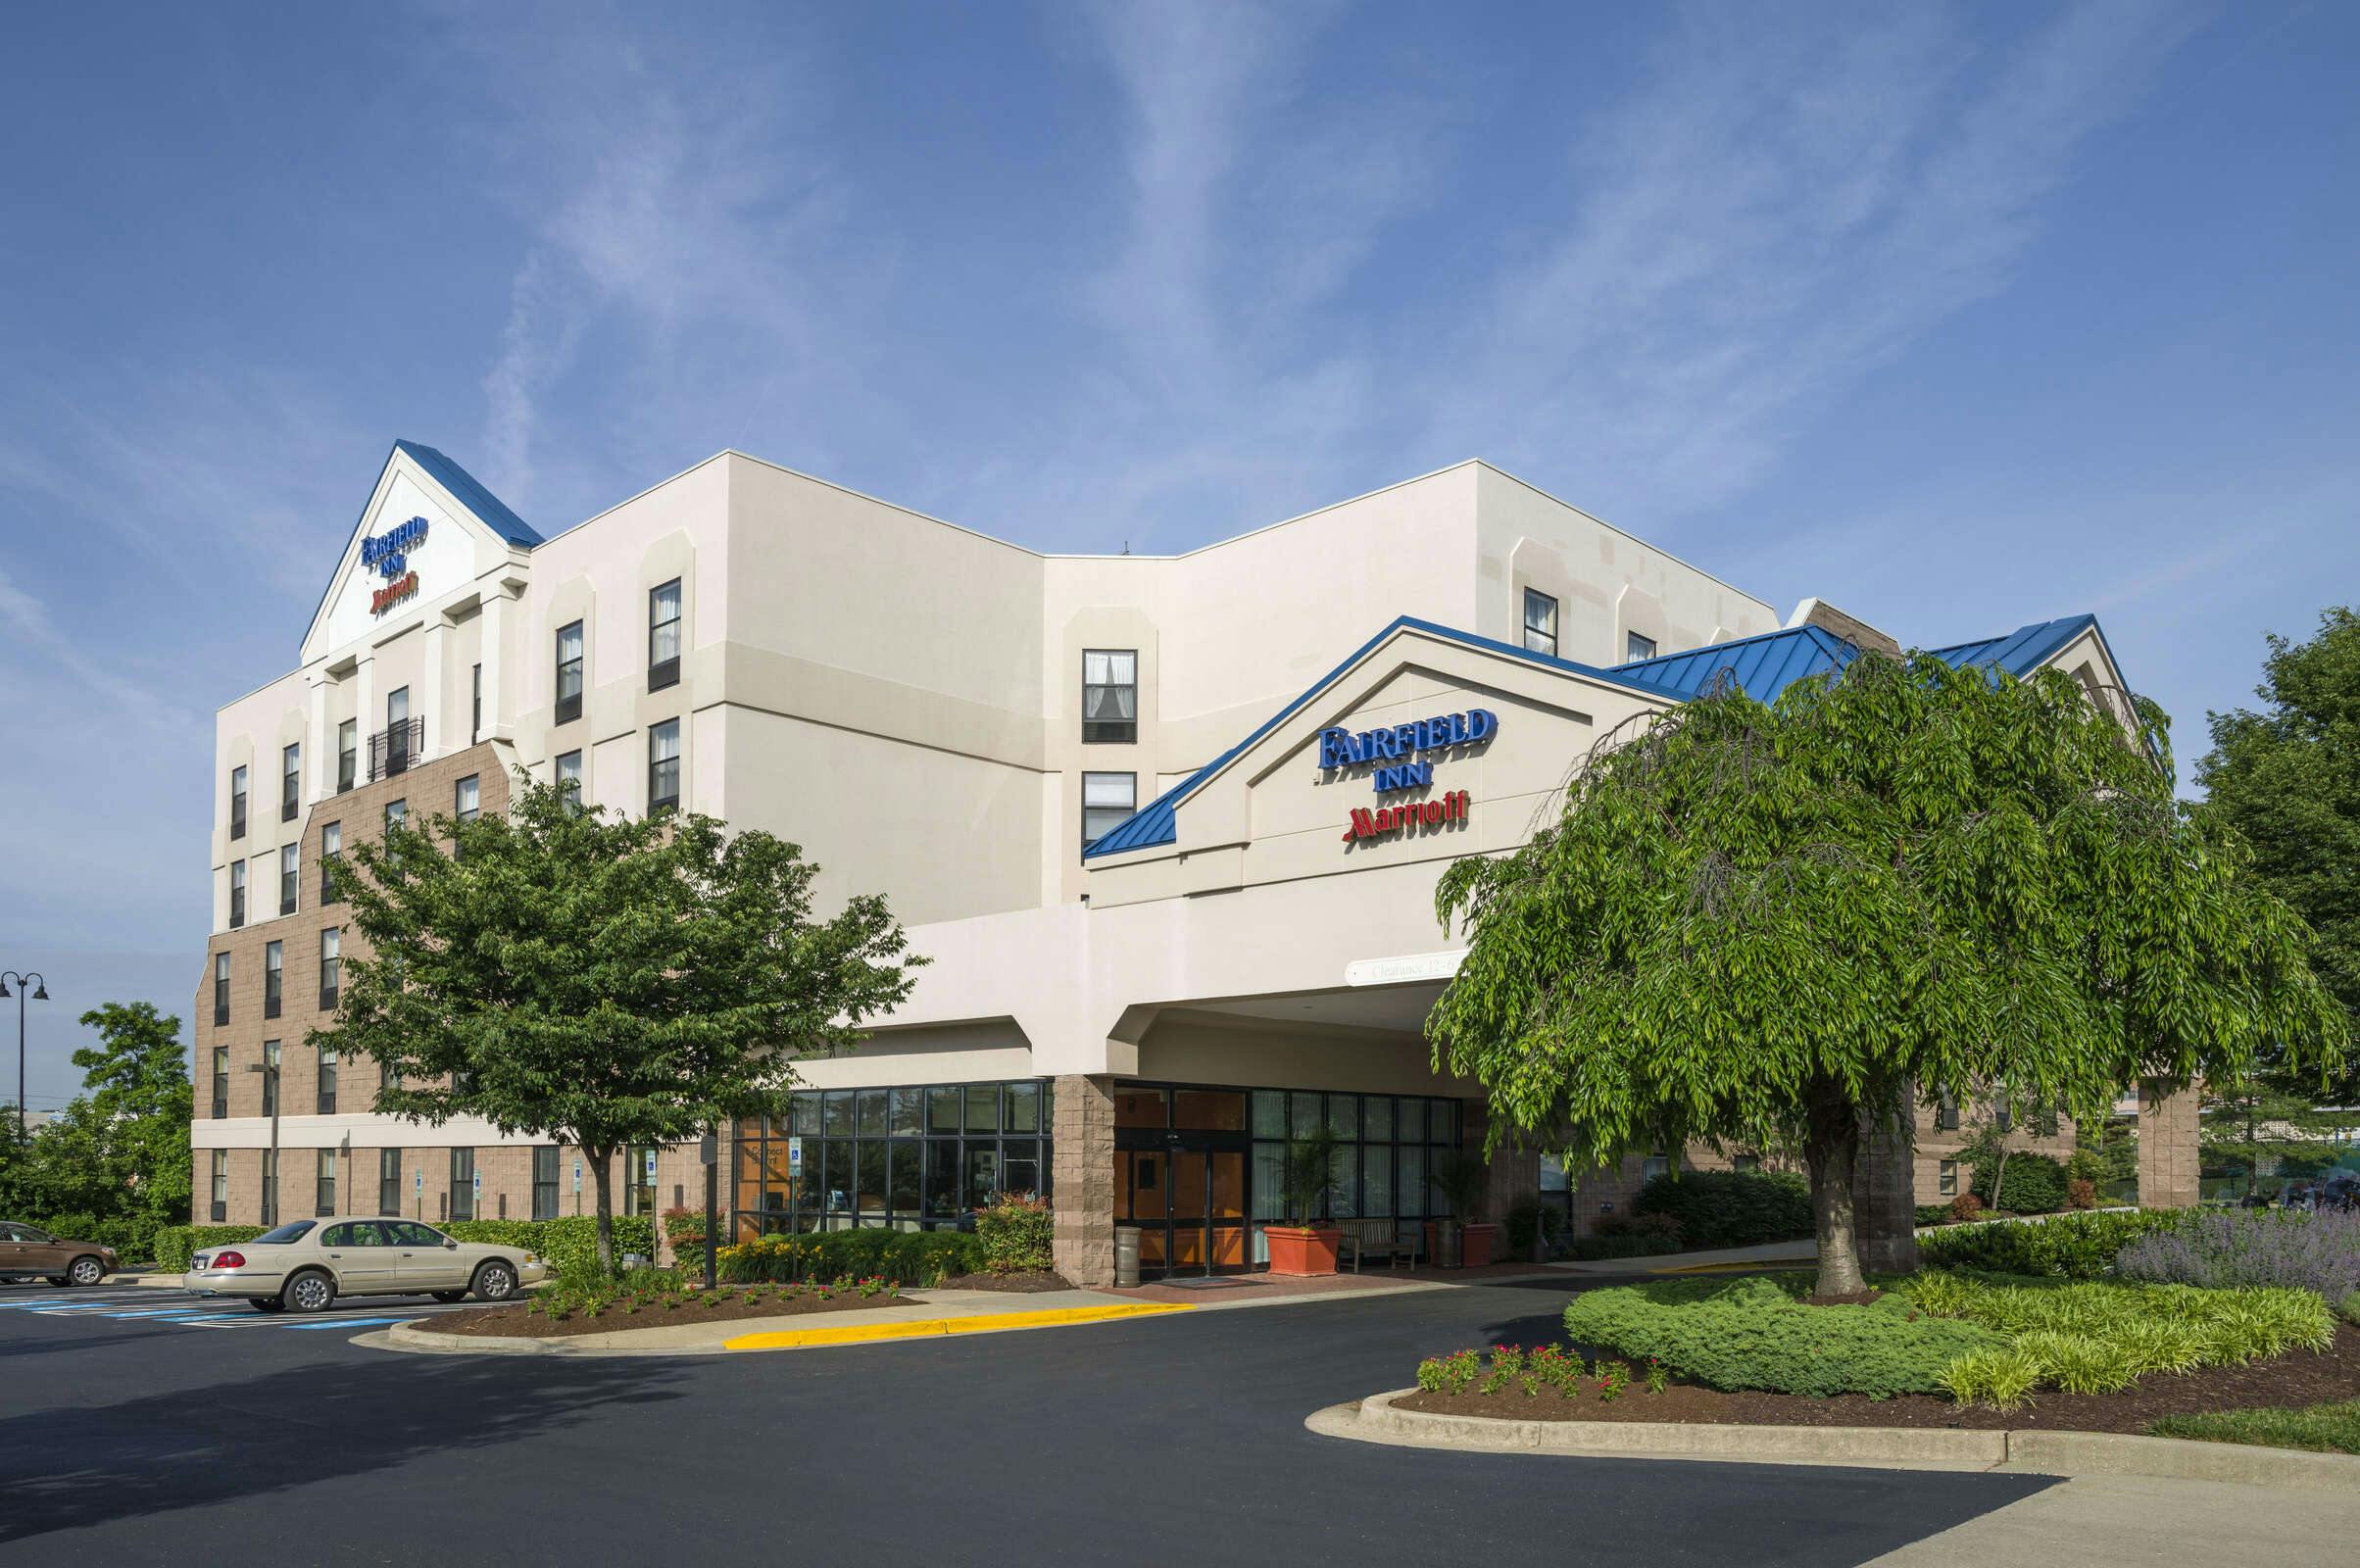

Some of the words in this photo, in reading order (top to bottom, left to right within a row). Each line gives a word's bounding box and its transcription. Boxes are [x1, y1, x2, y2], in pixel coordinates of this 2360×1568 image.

[361, 515, 428, 567] FAIRFIELD
[379, 553, 407, 578] INN
[1317, 709, 1499, 769] FAIRFIELD
[1373, 760, 1434, 793] INN
[1342, 790, 1471, 842] Marriott
